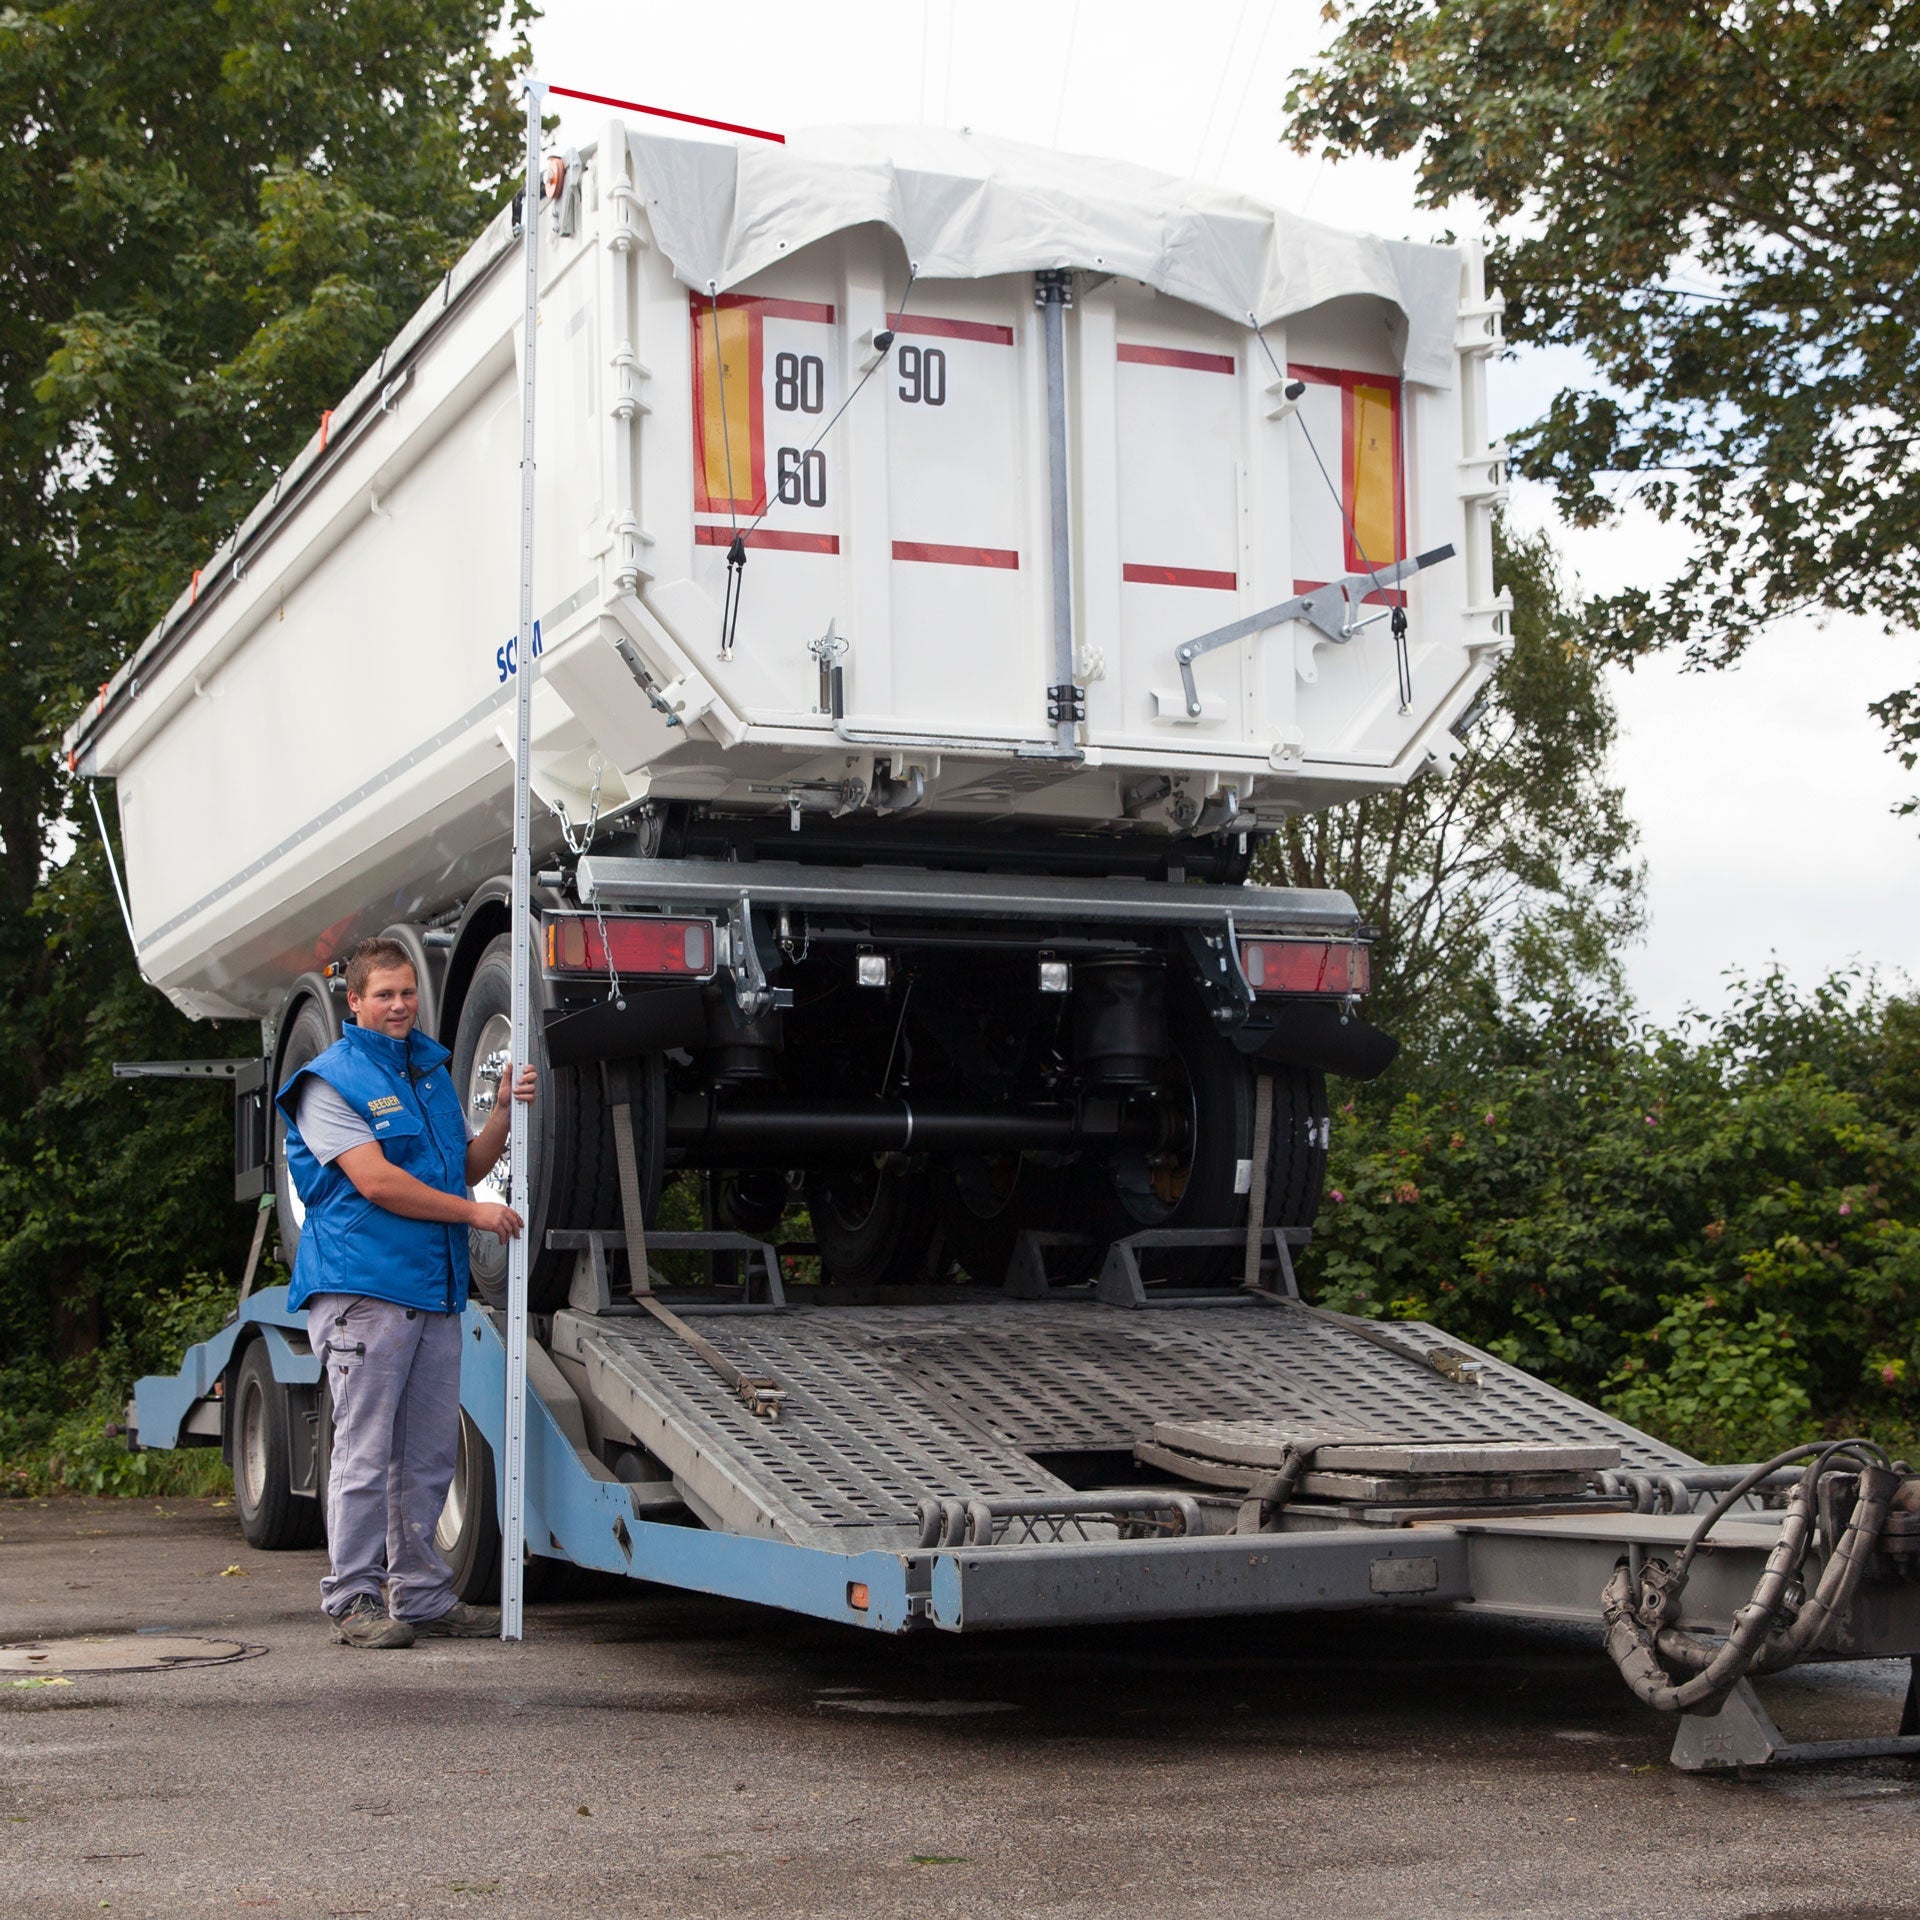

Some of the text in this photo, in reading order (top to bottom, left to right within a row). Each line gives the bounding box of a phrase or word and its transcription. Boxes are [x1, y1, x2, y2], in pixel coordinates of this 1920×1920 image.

[775, 351, 824, 414] 80
[898, 345, 946, 407] 90
[777, 446, 827, 508] 60
[368, 1096, 400, 1111] SEEGER
